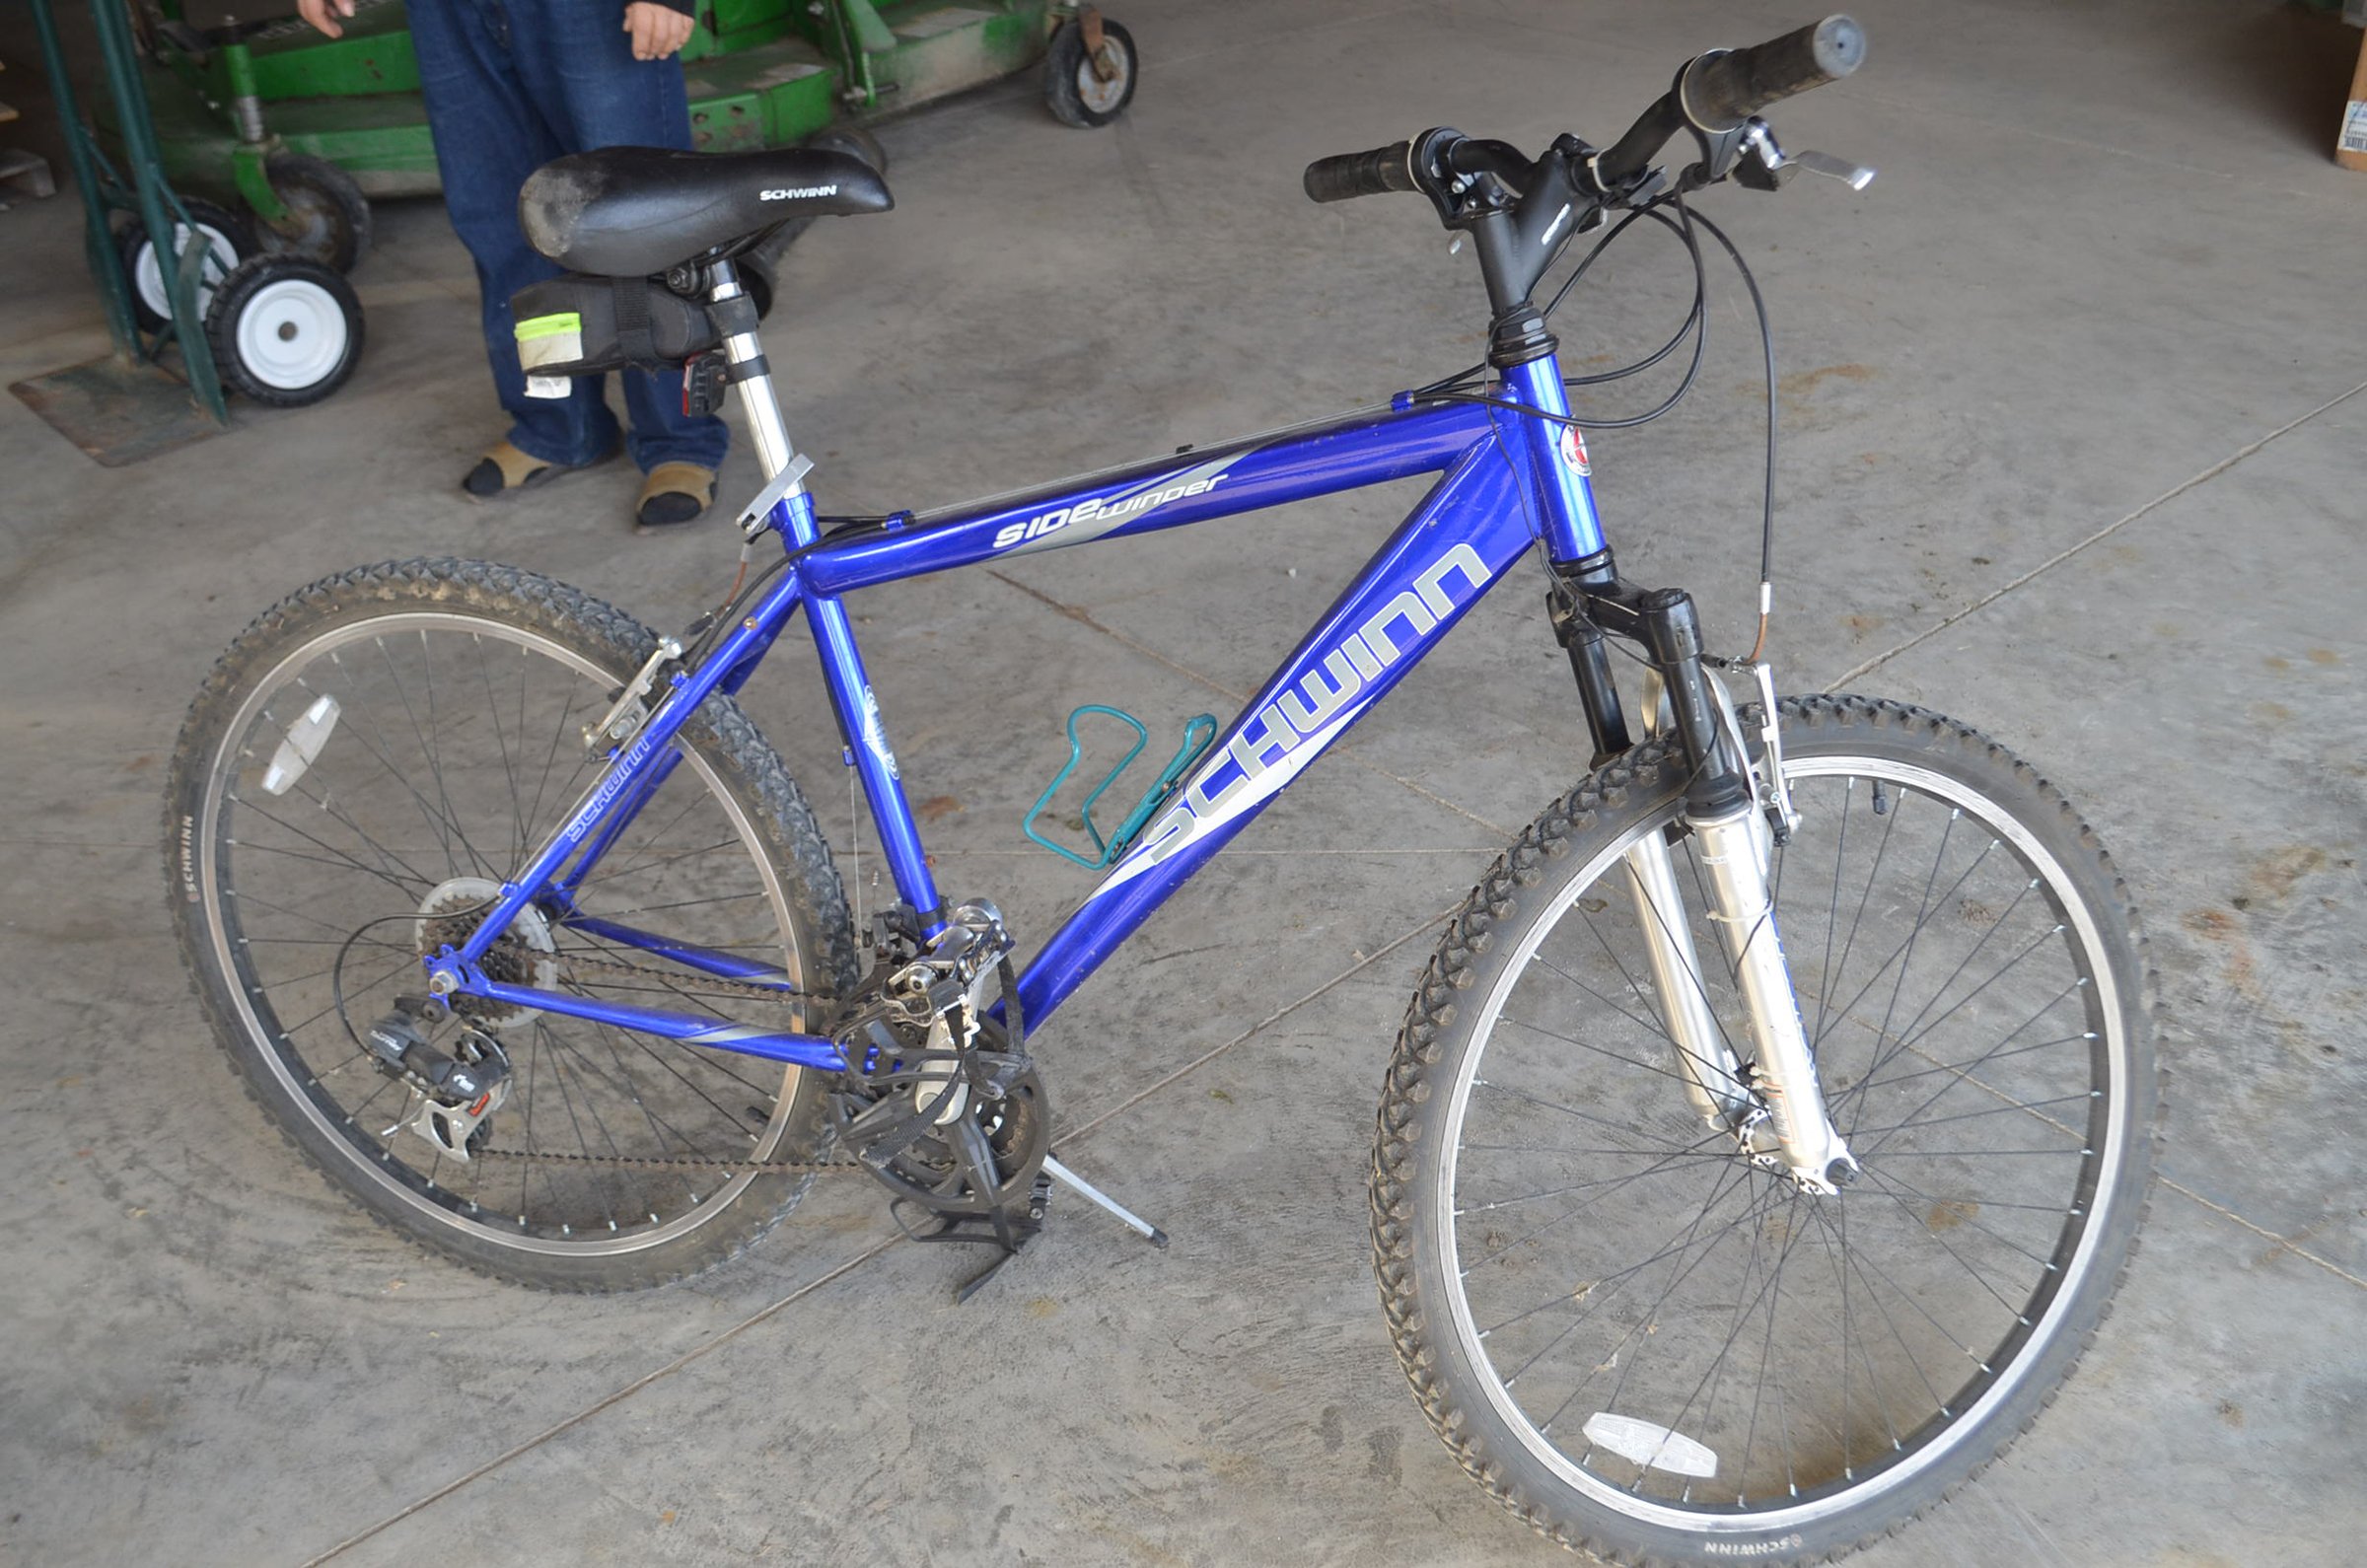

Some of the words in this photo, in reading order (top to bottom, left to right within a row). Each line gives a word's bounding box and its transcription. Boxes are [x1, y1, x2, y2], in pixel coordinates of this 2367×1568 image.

[759, 184, 837, 201] SCHWINN
[1142, 542, 1493, 866] SCHWINN
[567, 737, 651, 843] SCHWINN
[180, 816, 197, 891] SCHWINN
[1704, 1536, 1790, 1555] SCHWINN
